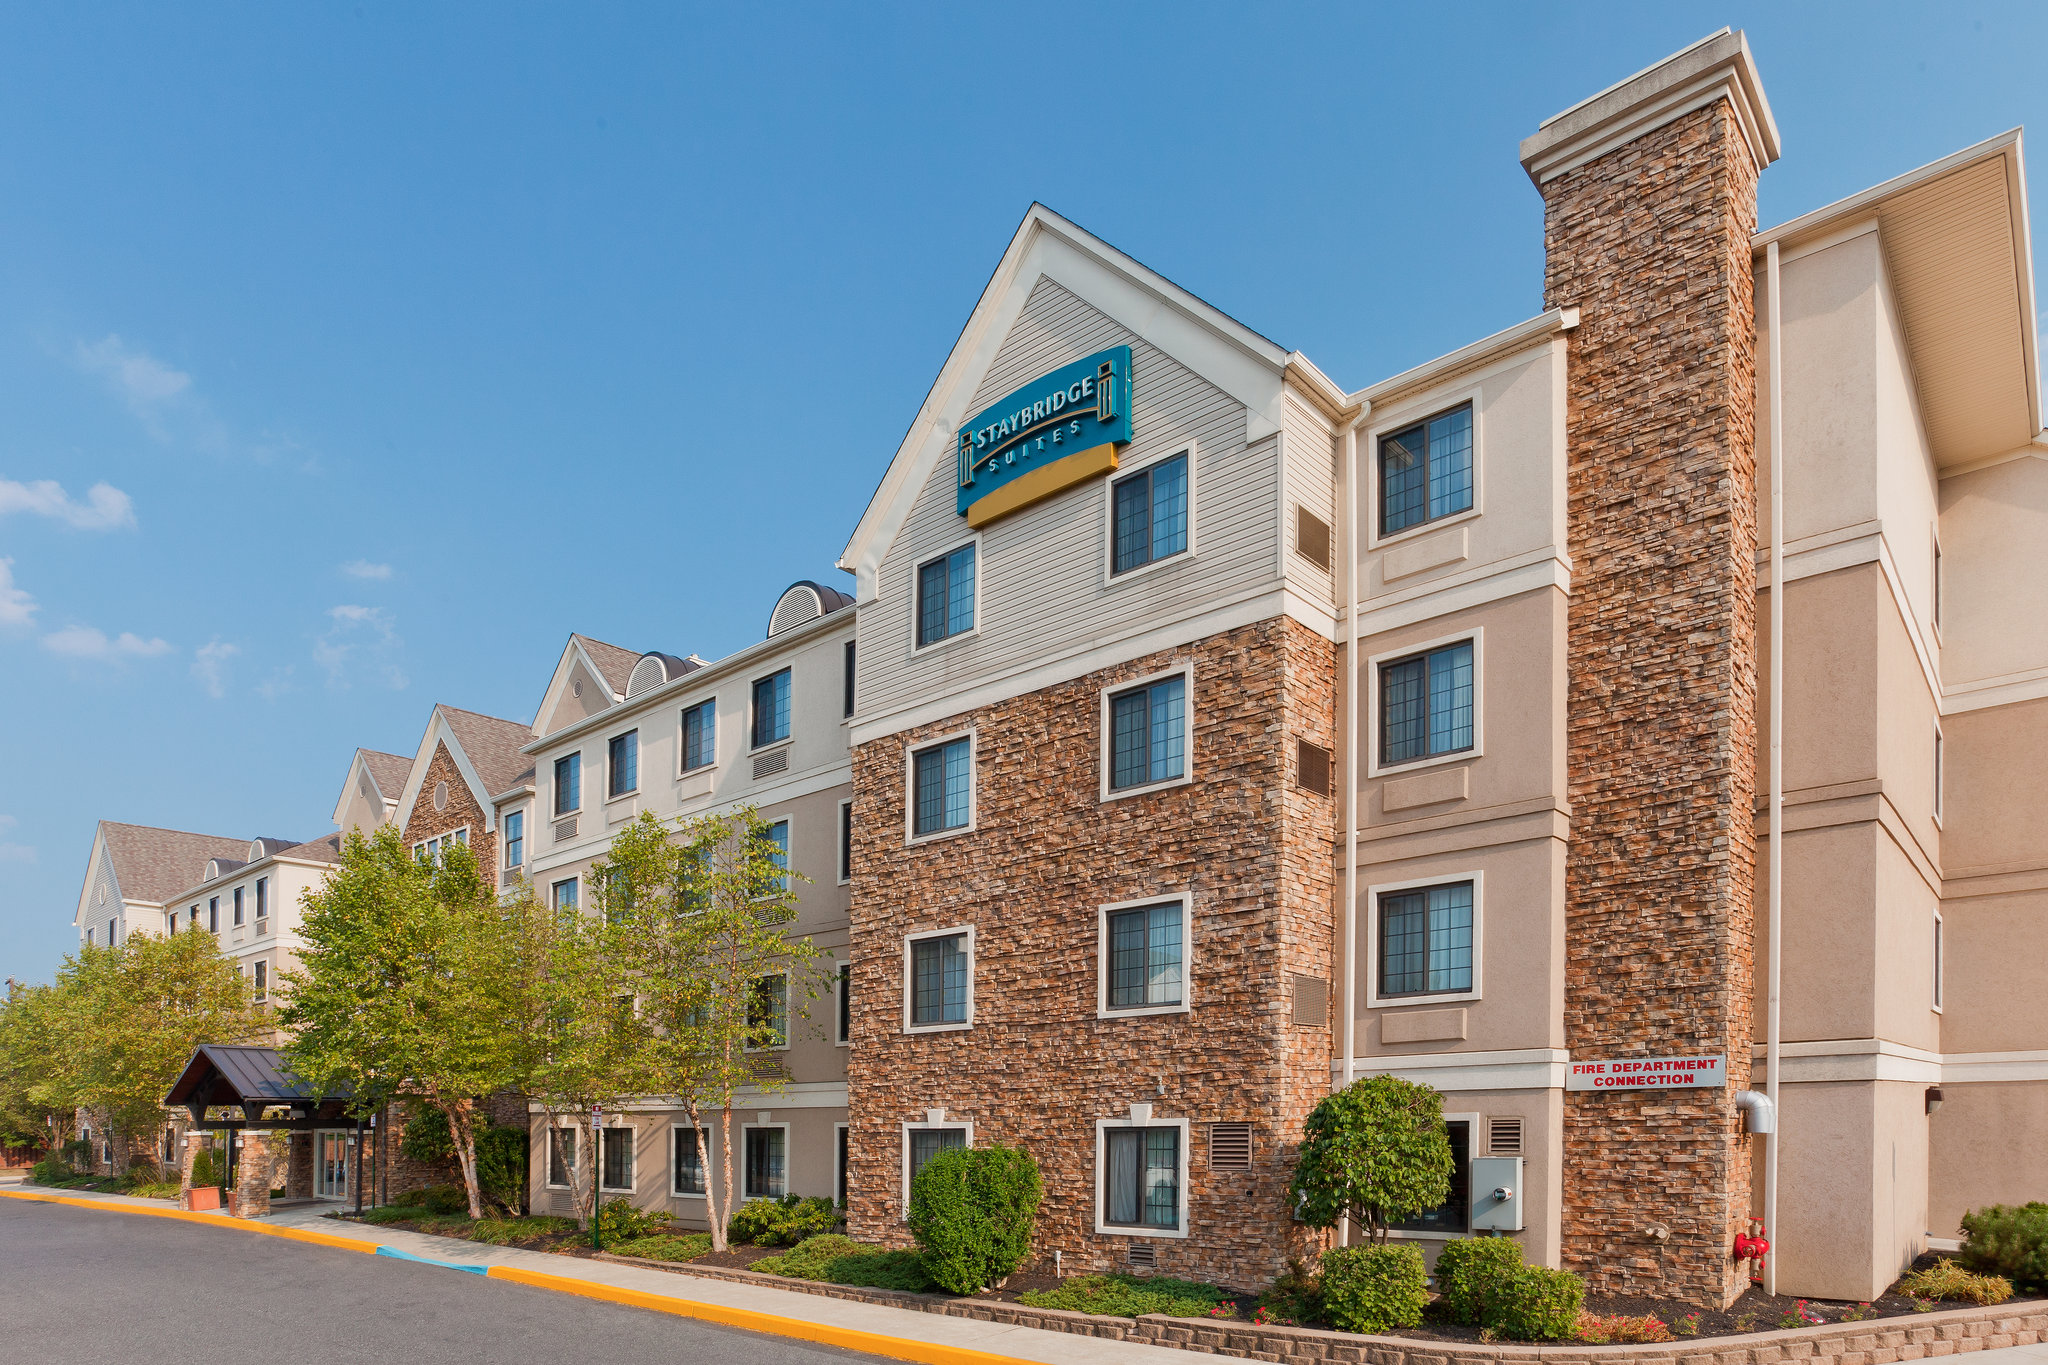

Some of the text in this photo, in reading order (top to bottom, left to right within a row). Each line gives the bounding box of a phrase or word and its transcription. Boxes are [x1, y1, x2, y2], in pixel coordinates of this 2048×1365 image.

[977, 375, 1094, 449] STAYBRIDGE
[988, 420, 1081, 473] SUITES
[1573, 1059, 1718, 1075] FIRE DEPARTMENT
[1593, 1074, 1694, 1087] CONNECTION
